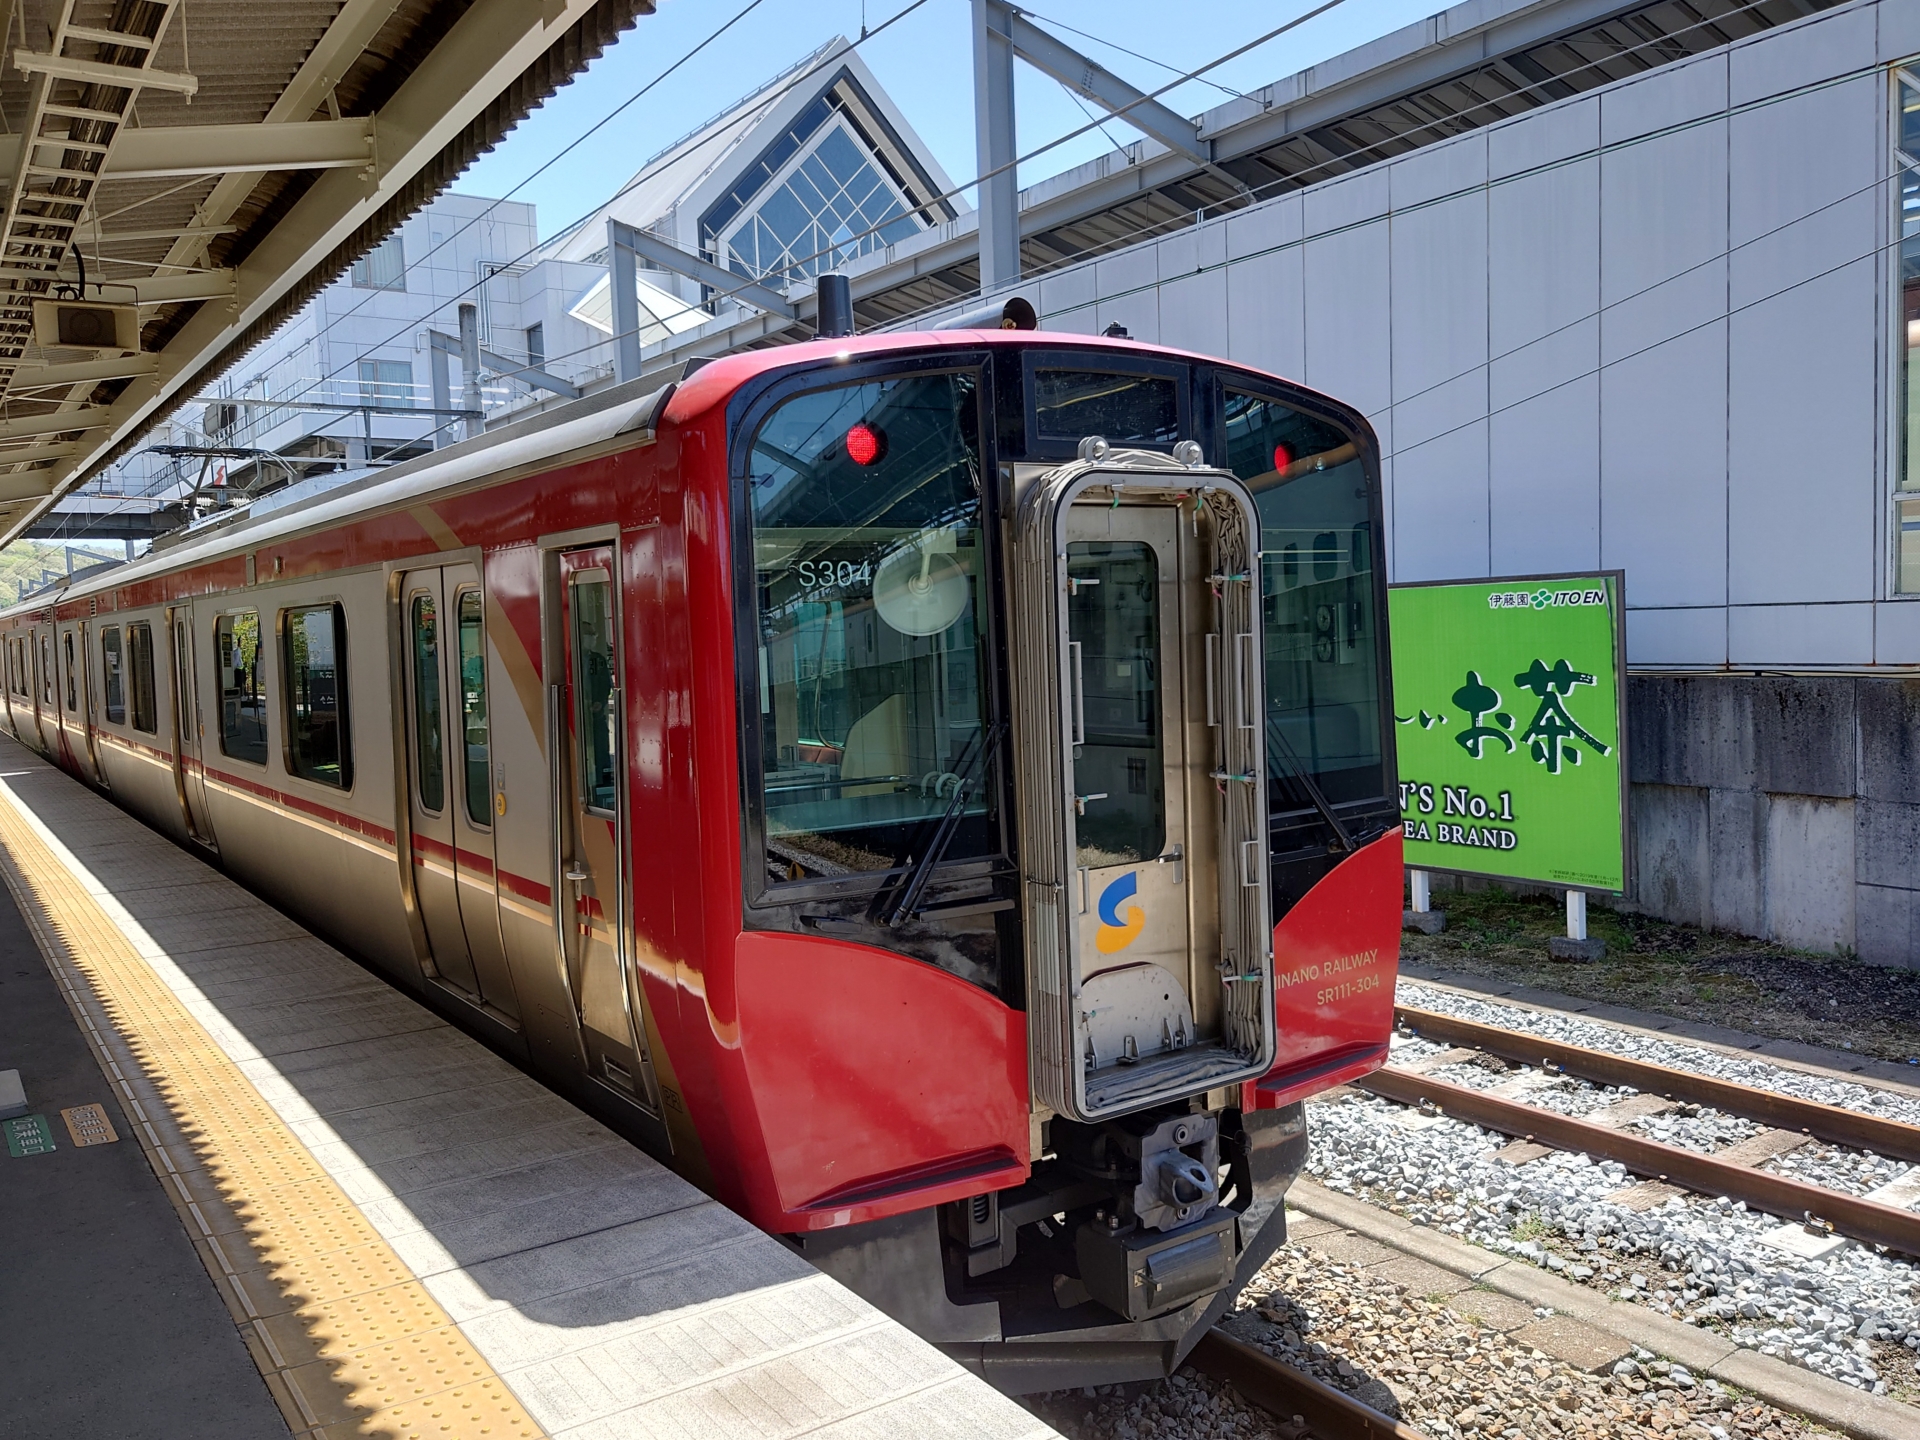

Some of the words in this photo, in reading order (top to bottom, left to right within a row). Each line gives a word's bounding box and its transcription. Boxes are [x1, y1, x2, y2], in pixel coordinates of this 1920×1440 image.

[798, 560, 872, 587] S304
[1488, 593, 1529, 608] 伊藤園
[1553, 591, 1581, 605] ITO
[1443, 787, 1513, 820] No.1
[1437, 824, 1517, 849] BRAND
[1323, 949, 1379, 977] RAILWAY
[1316, 973, 1380, 1006] SR111-304
